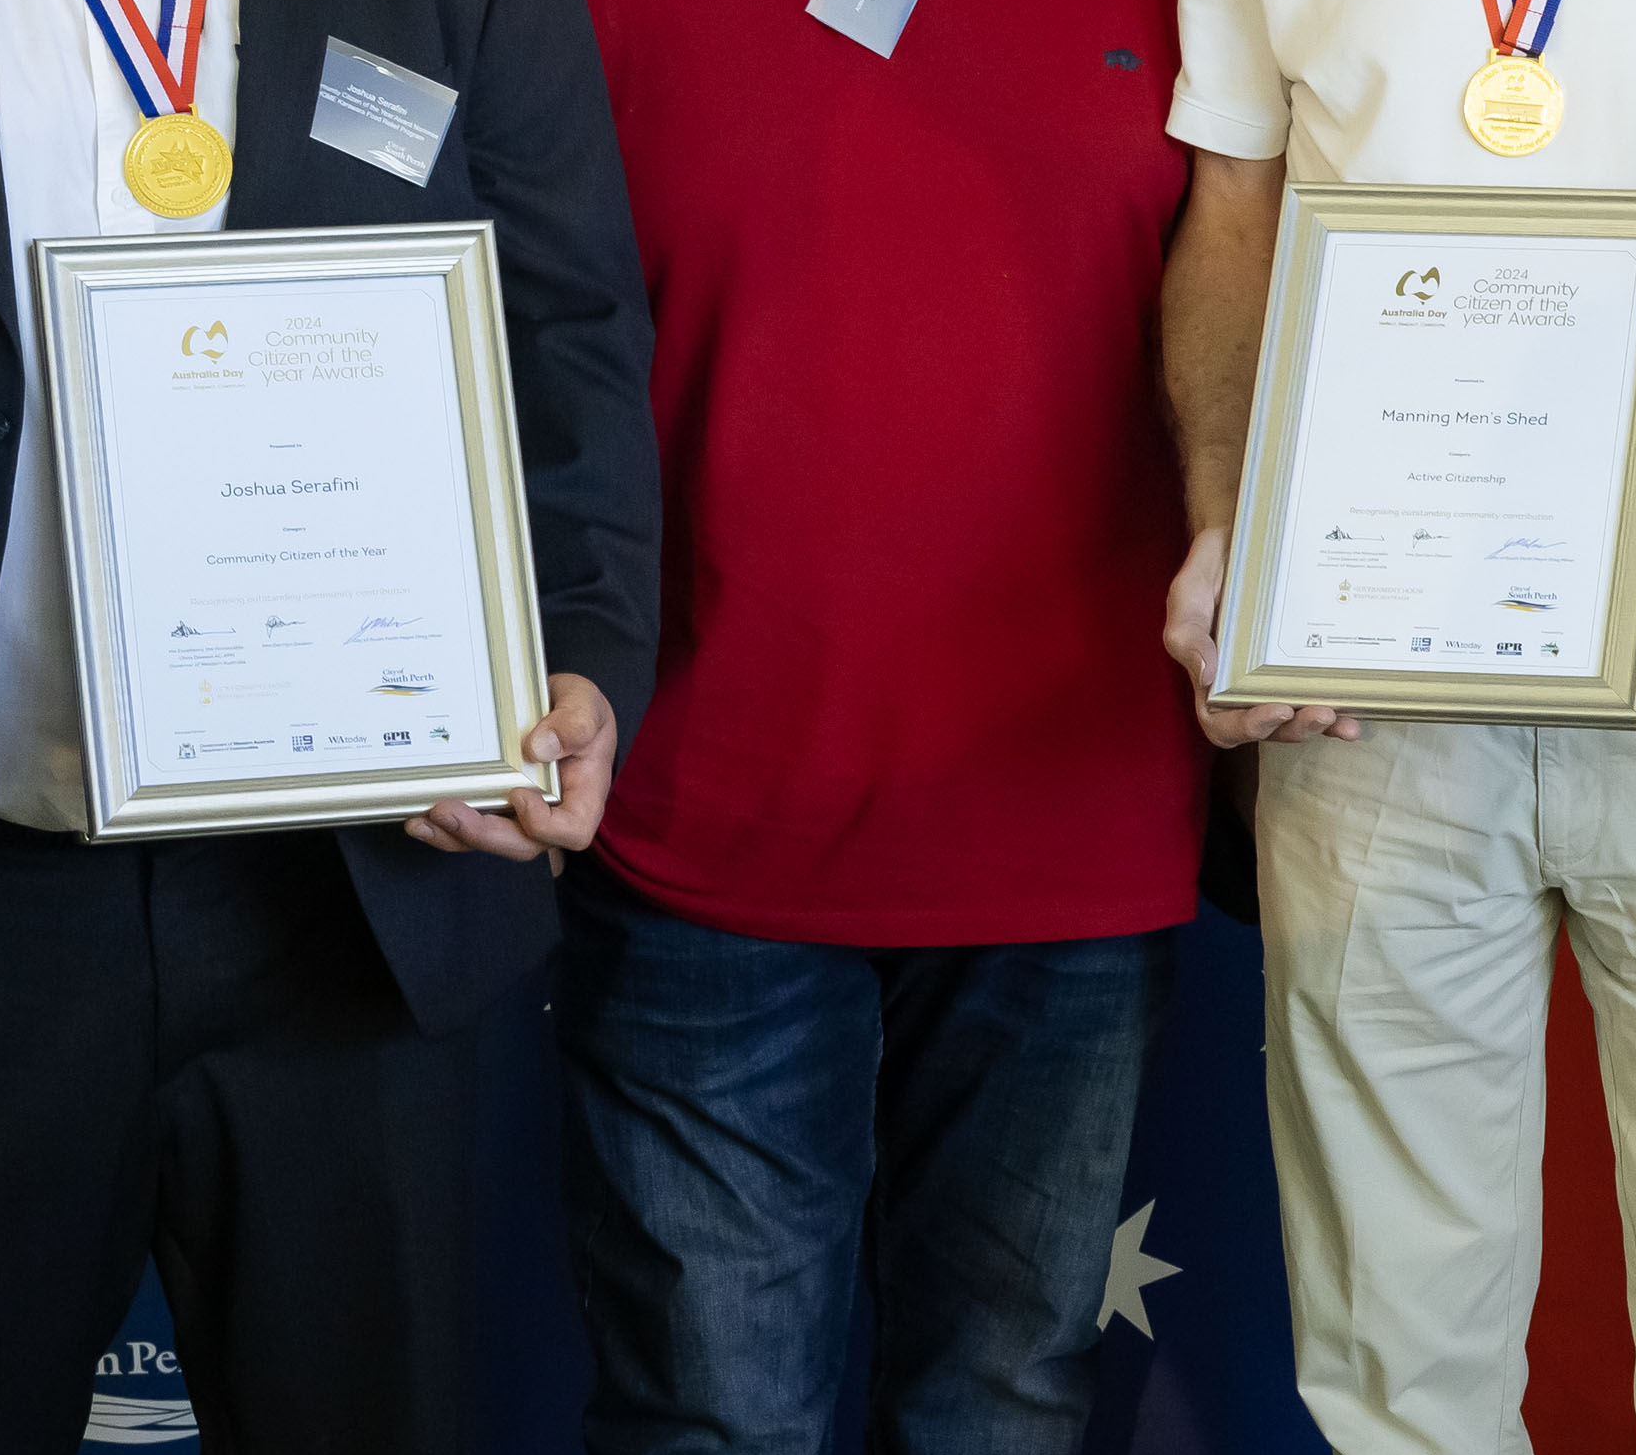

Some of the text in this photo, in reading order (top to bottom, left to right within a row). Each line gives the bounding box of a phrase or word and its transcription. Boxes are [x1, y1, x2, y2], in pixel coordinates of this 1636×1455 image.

[346, 83, 376, 100] Joshua
[376, 96, 407, 114] Serafini
[1495, 268, 1529, 280] 2024
[1473, 279, 1579, 300] Community
[1453, 295, 1568, 312] Citizen of the
[1381, 308, 1447, 319] Australia Day
[1463, 313, 1503, 328] year
[1508, 311, 1576, 327] Awards
[285, 317, 322, 330] 2024
[266, 329, 379, 347] Community
[248, 347, 372, 366] Citizen of the
[172, 369, 244, 380] Australia Day
[261, 368, 304, 387] year
[312, 362, 384, 380] Awards
[1382, 409, 1548, 427] Manning Men's Shed
[1407, 472, 1506, 485] Active Citizenship
[221, 477, 360, 498] Joshua Serafini
[206, 546, 387, 565] Community Citizen of the Year
[1510, 585, 1524, 593] City
[1508, 592, 1557, 600] South Perth
[1446, 641, 1483, 650] WAtoday
[1497, 642, 1522, 651] 6PR
[382, 669, 397, 677] City
[382, 673, 434, 684] South Perth
[328, 736, 367, 744] WAtoday
[383, 731, 411, 741] 6PR
